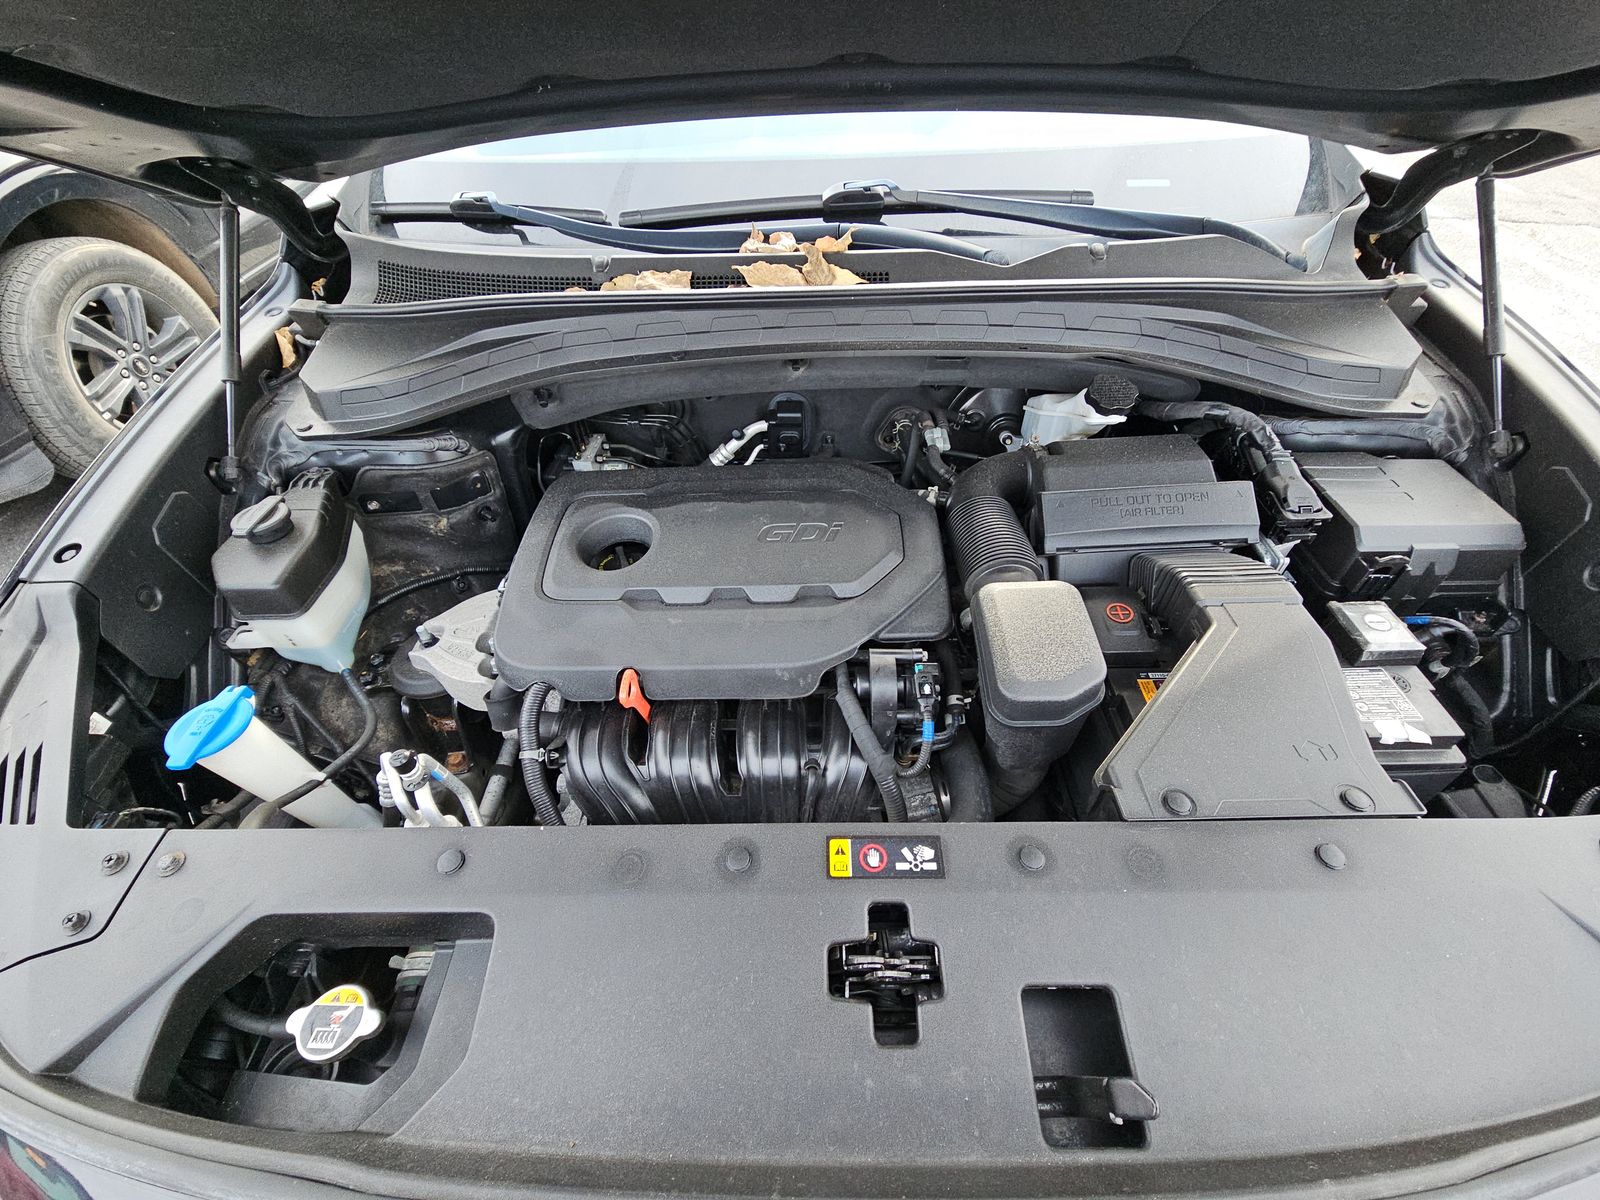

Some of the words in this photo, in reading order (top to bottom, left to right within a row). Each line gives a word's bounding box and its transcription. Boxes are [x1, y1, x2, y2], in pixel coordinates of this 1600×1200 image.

[1091, 496, 1123, 508] PULL
[1126, 494, 1152, 505] OUT
[1154, 493, 1172, 504] TO
[1175, 491, 1209, 503] OPEN
